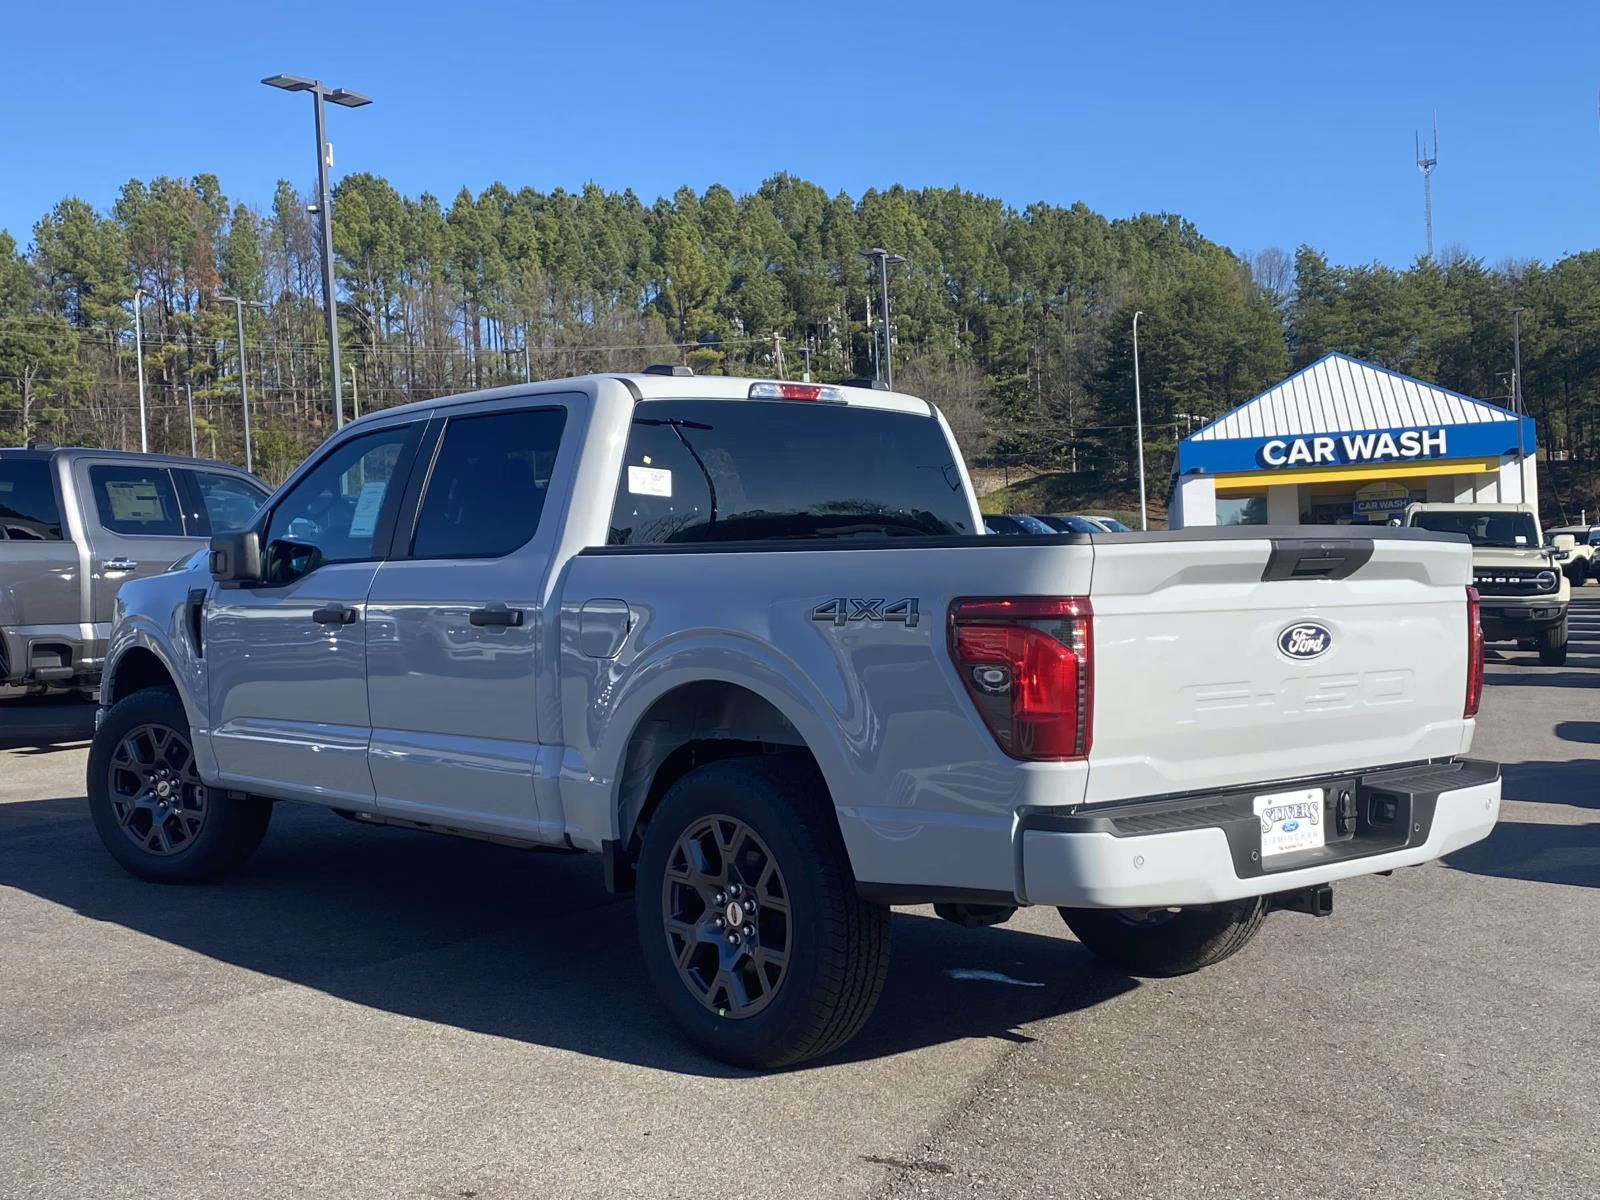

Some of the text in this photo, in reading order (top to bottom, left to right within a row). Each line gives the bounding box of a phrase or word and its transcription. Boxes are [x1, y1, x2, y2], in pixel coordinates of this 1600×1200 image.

[1261, 429, 1447, 466] CAR WASH
[1358, 499, 1407, 511] CAR WASH
[1288, 628, 1325, 653] Ford
[1262, 801, 1319, 834] STIVERS
